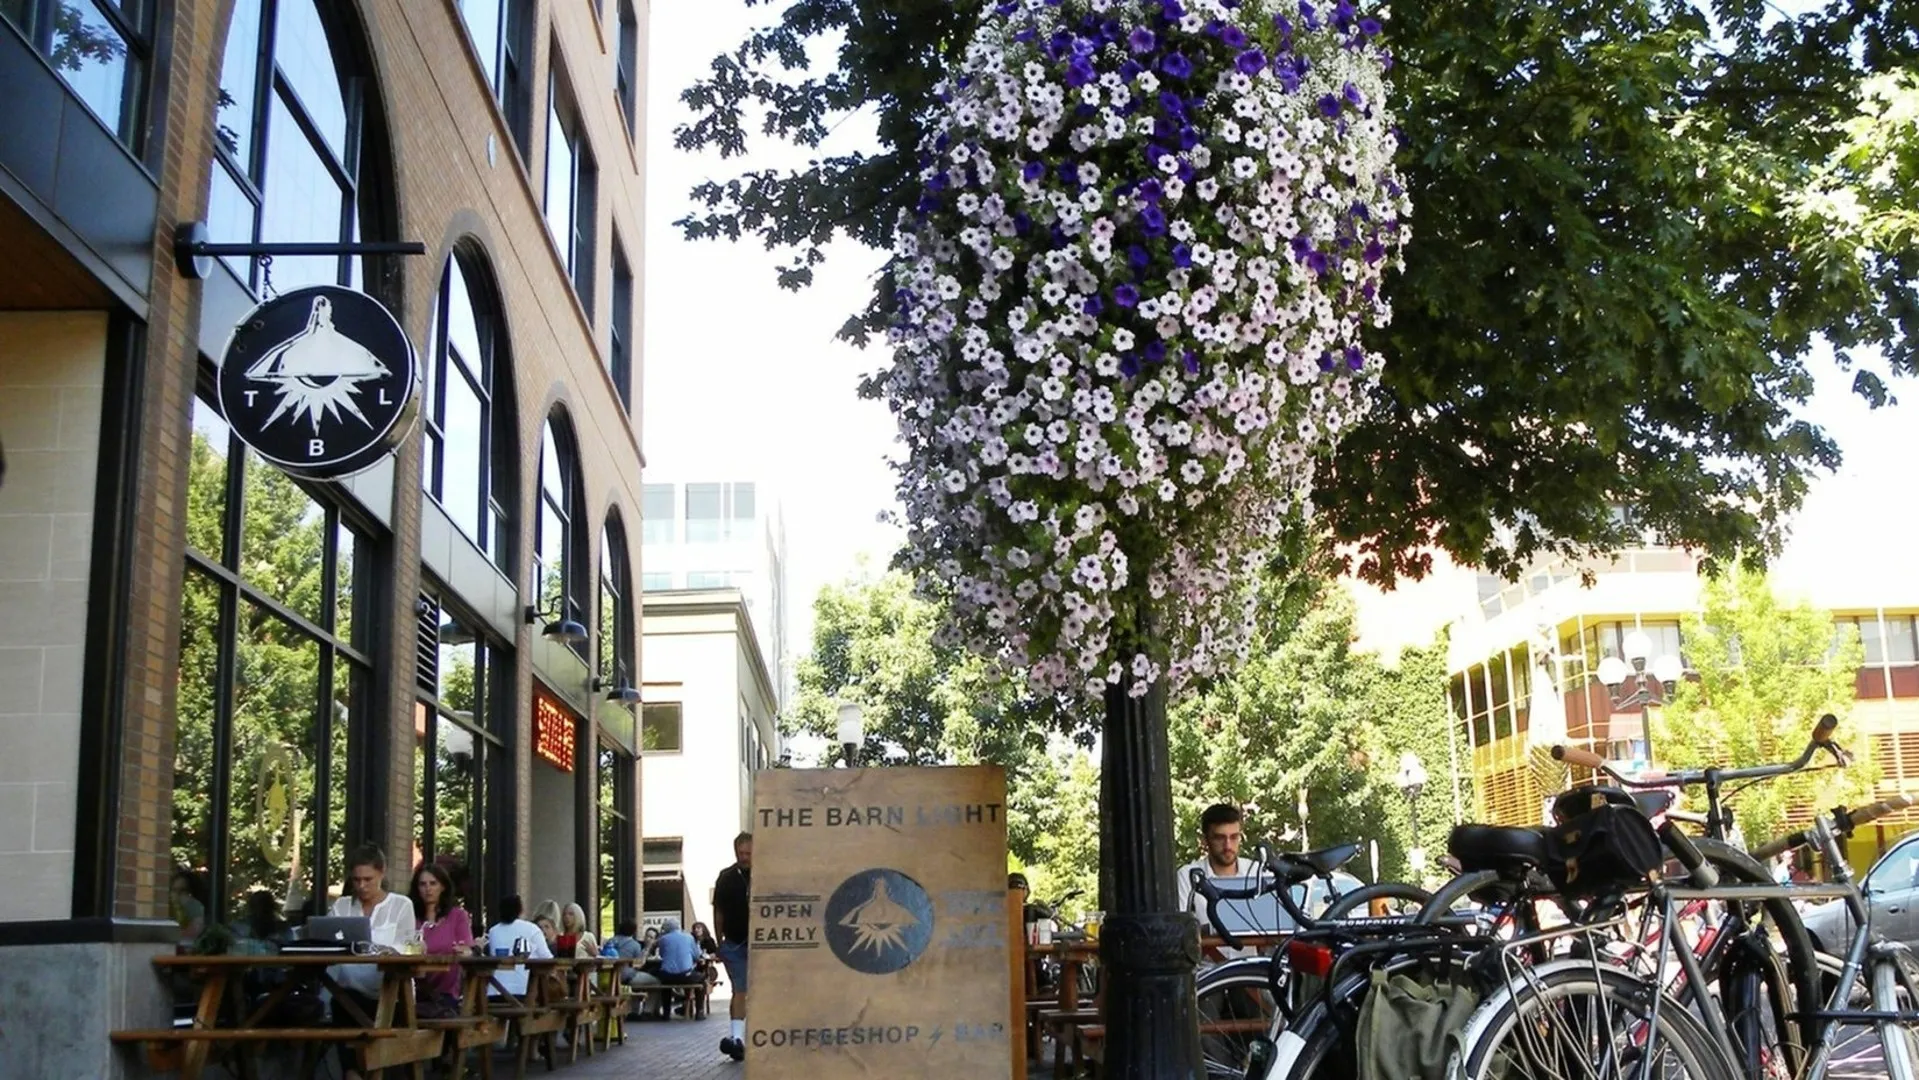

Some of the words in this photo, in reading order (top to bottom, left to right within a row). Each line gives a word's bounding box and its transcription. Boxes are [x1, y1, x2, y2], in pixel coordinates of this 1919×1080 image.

[244, 390, 259, 407] T
[379, 388, 393, 405] L
[309, 438, 325, 456] B
[758, 807, 813, 827] THE
[826, 805, 904, 826] BARN
[760, 904, 812, 918] OPEN
[754, 927, 817, 941] EARLY
[752, 1025, 920, 1048] COFFEESHOP
